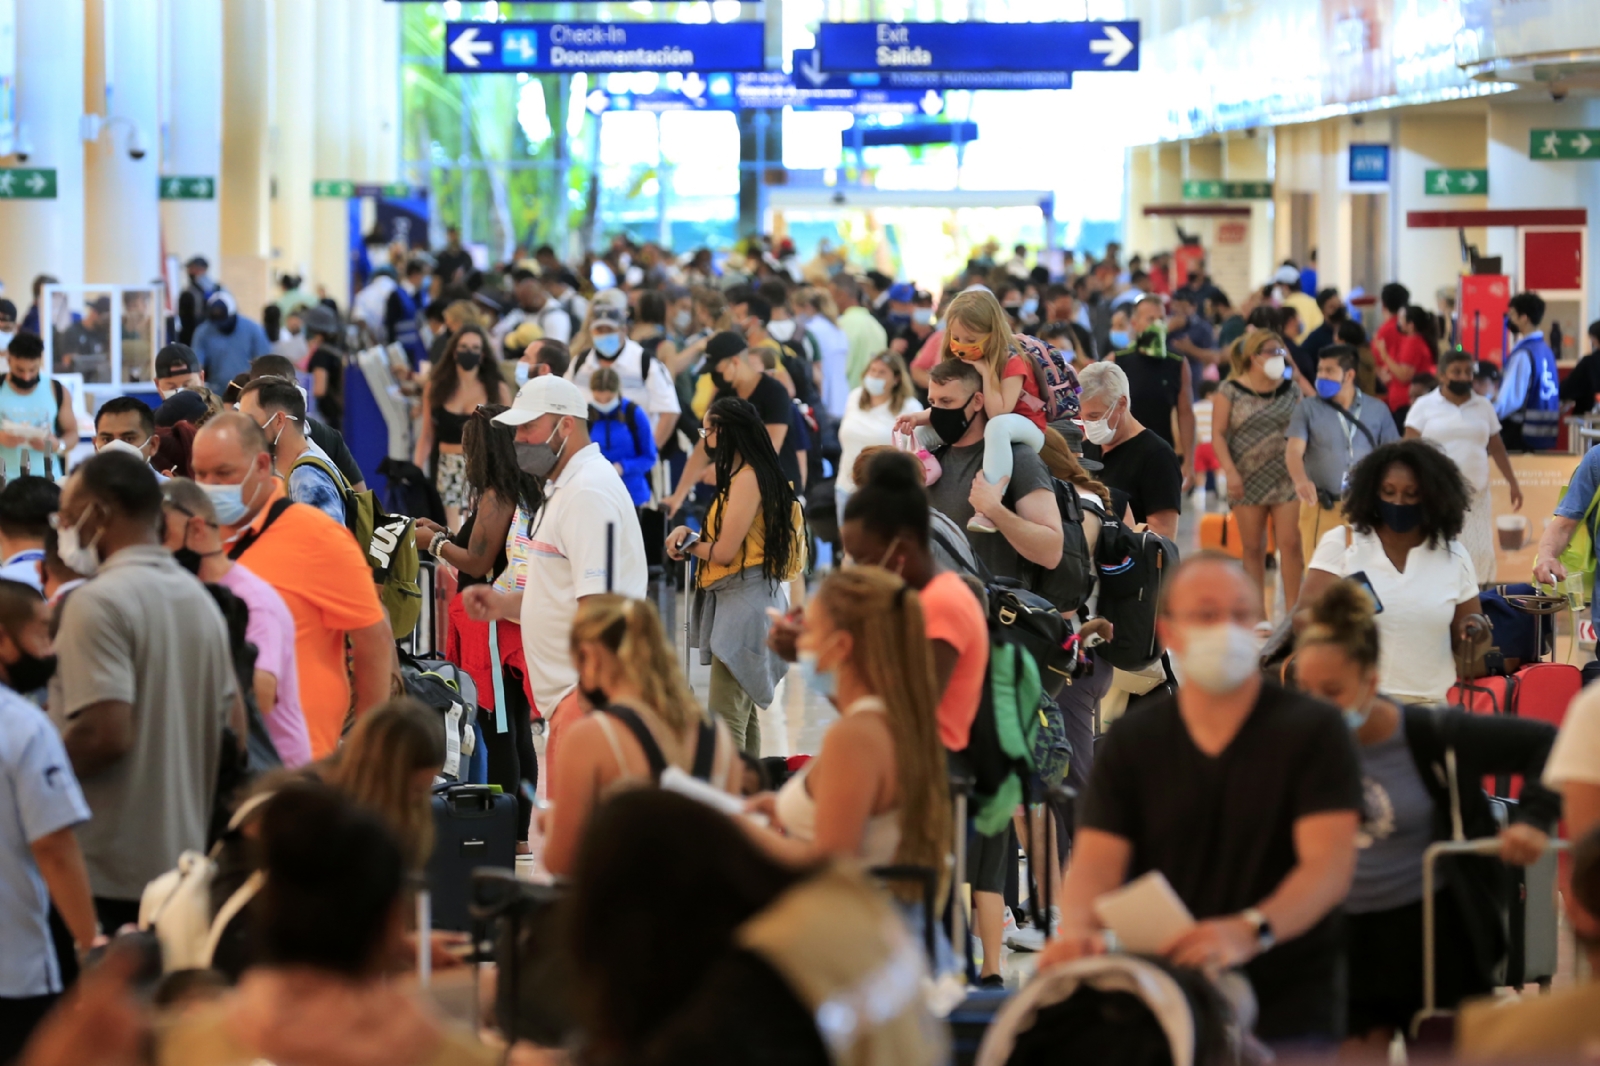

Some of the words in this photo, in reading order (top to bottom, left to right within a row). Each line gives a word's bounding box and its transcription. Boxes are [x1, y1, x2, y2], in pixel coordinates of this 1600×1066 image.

[550, 24, 627, 46] Check-In
[876, 23, 909, 45] Exit
[550, 45, 694, 67] Documentación
[876, 45, 932, 67] Salida
